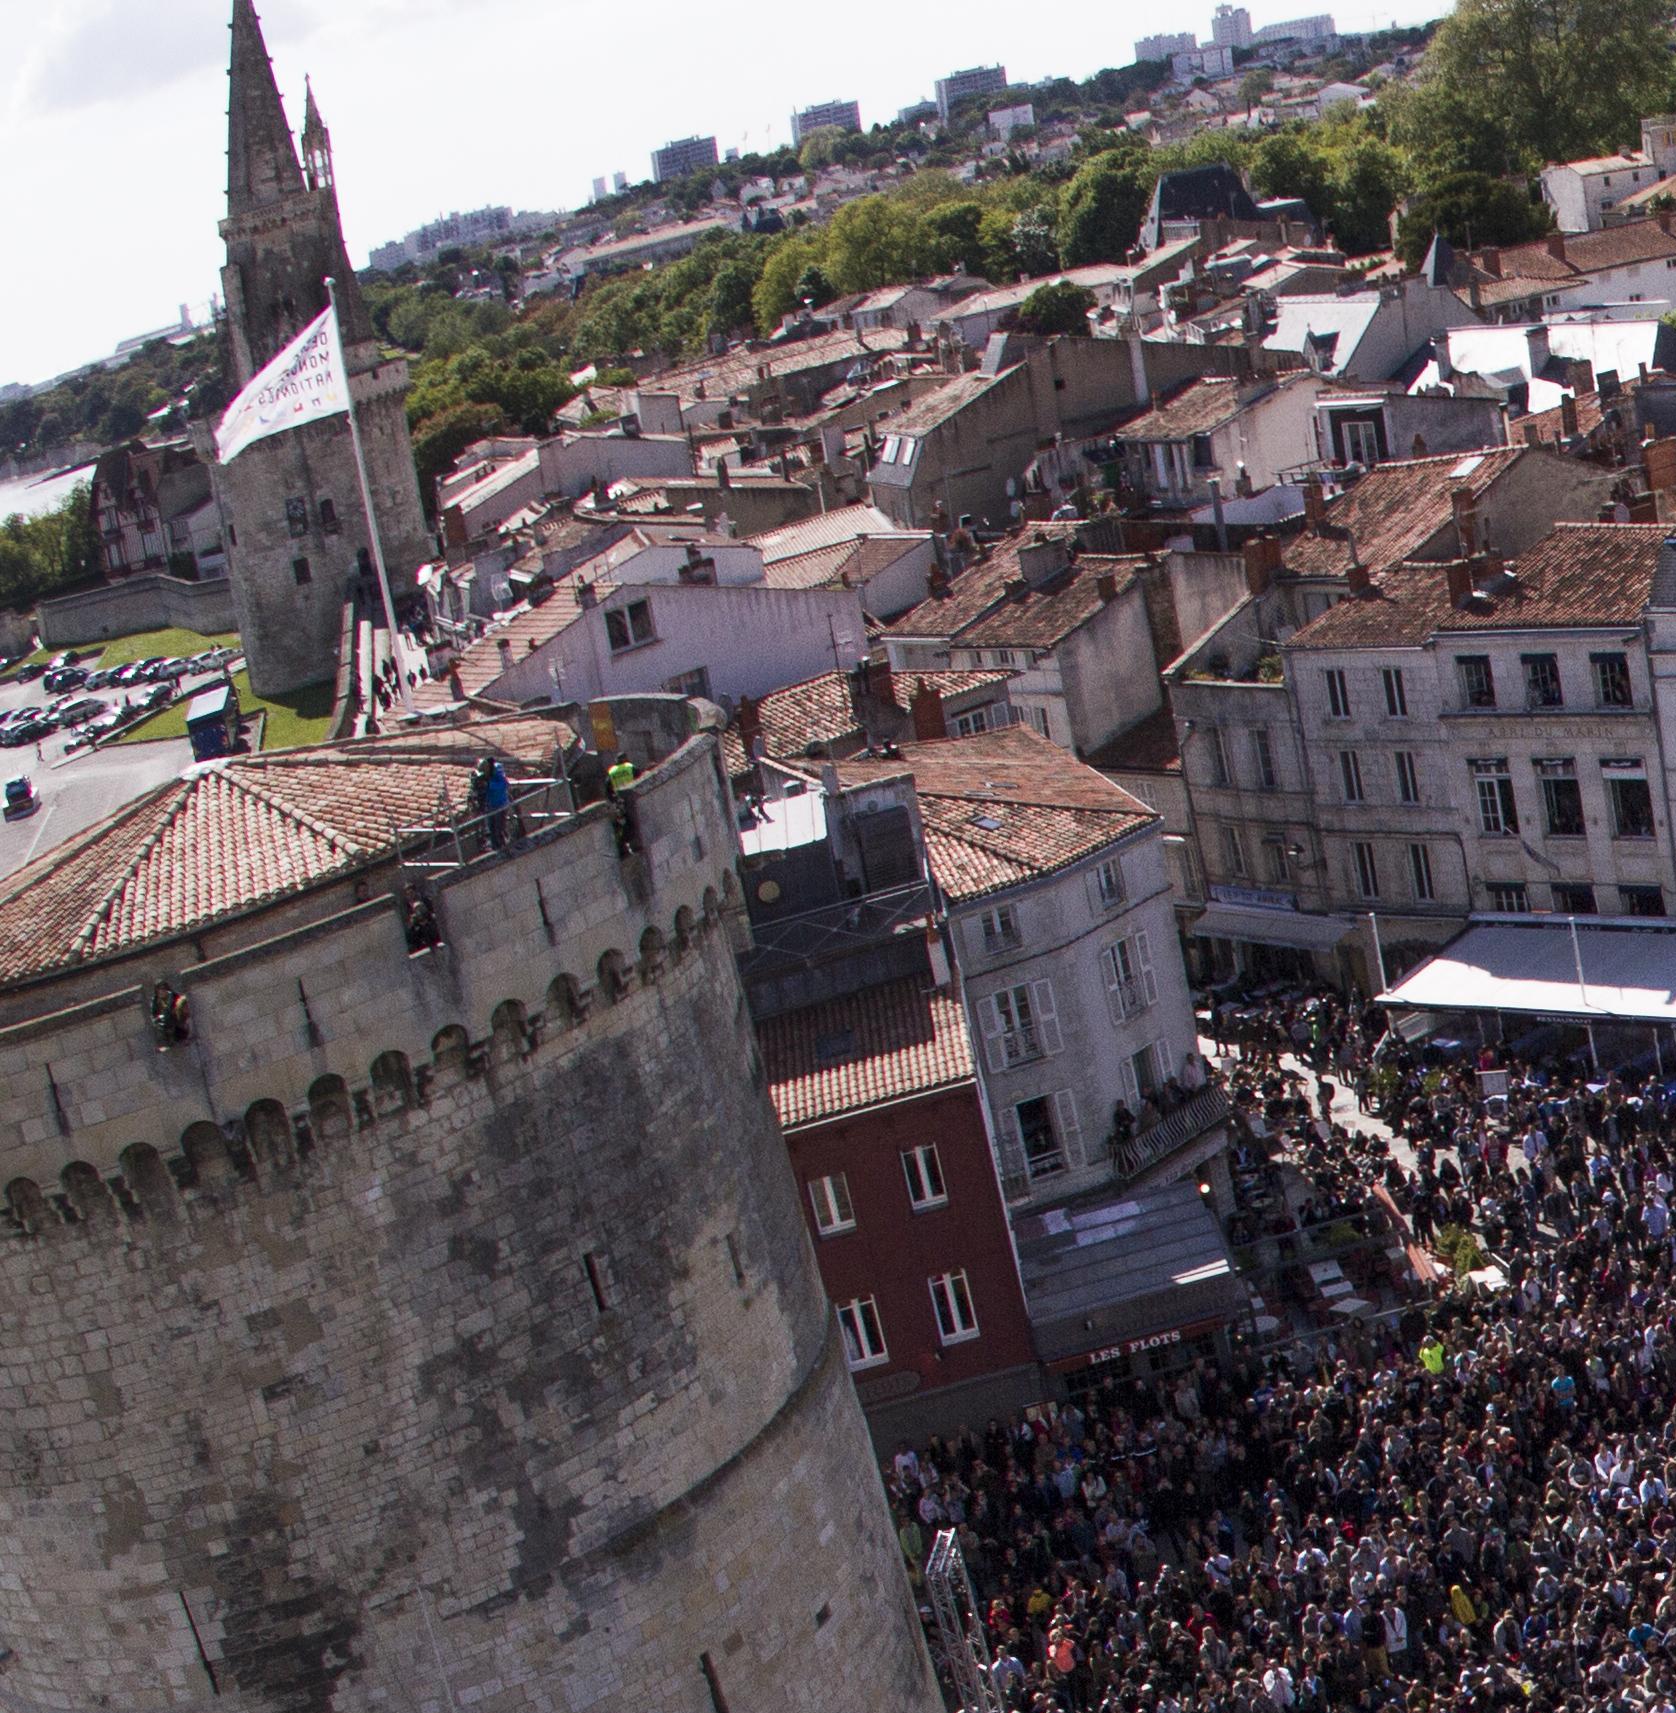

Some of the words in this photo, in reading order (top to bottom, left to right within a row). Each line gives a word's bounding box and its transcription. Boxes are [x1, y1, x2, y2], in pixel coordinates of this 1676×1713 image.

[1536, 1016, 1592, 1025] RESTAURANT
[1089, 1347, 1120, 1365] LES
[1129, 1330, 1181, 1353] FLOTS
